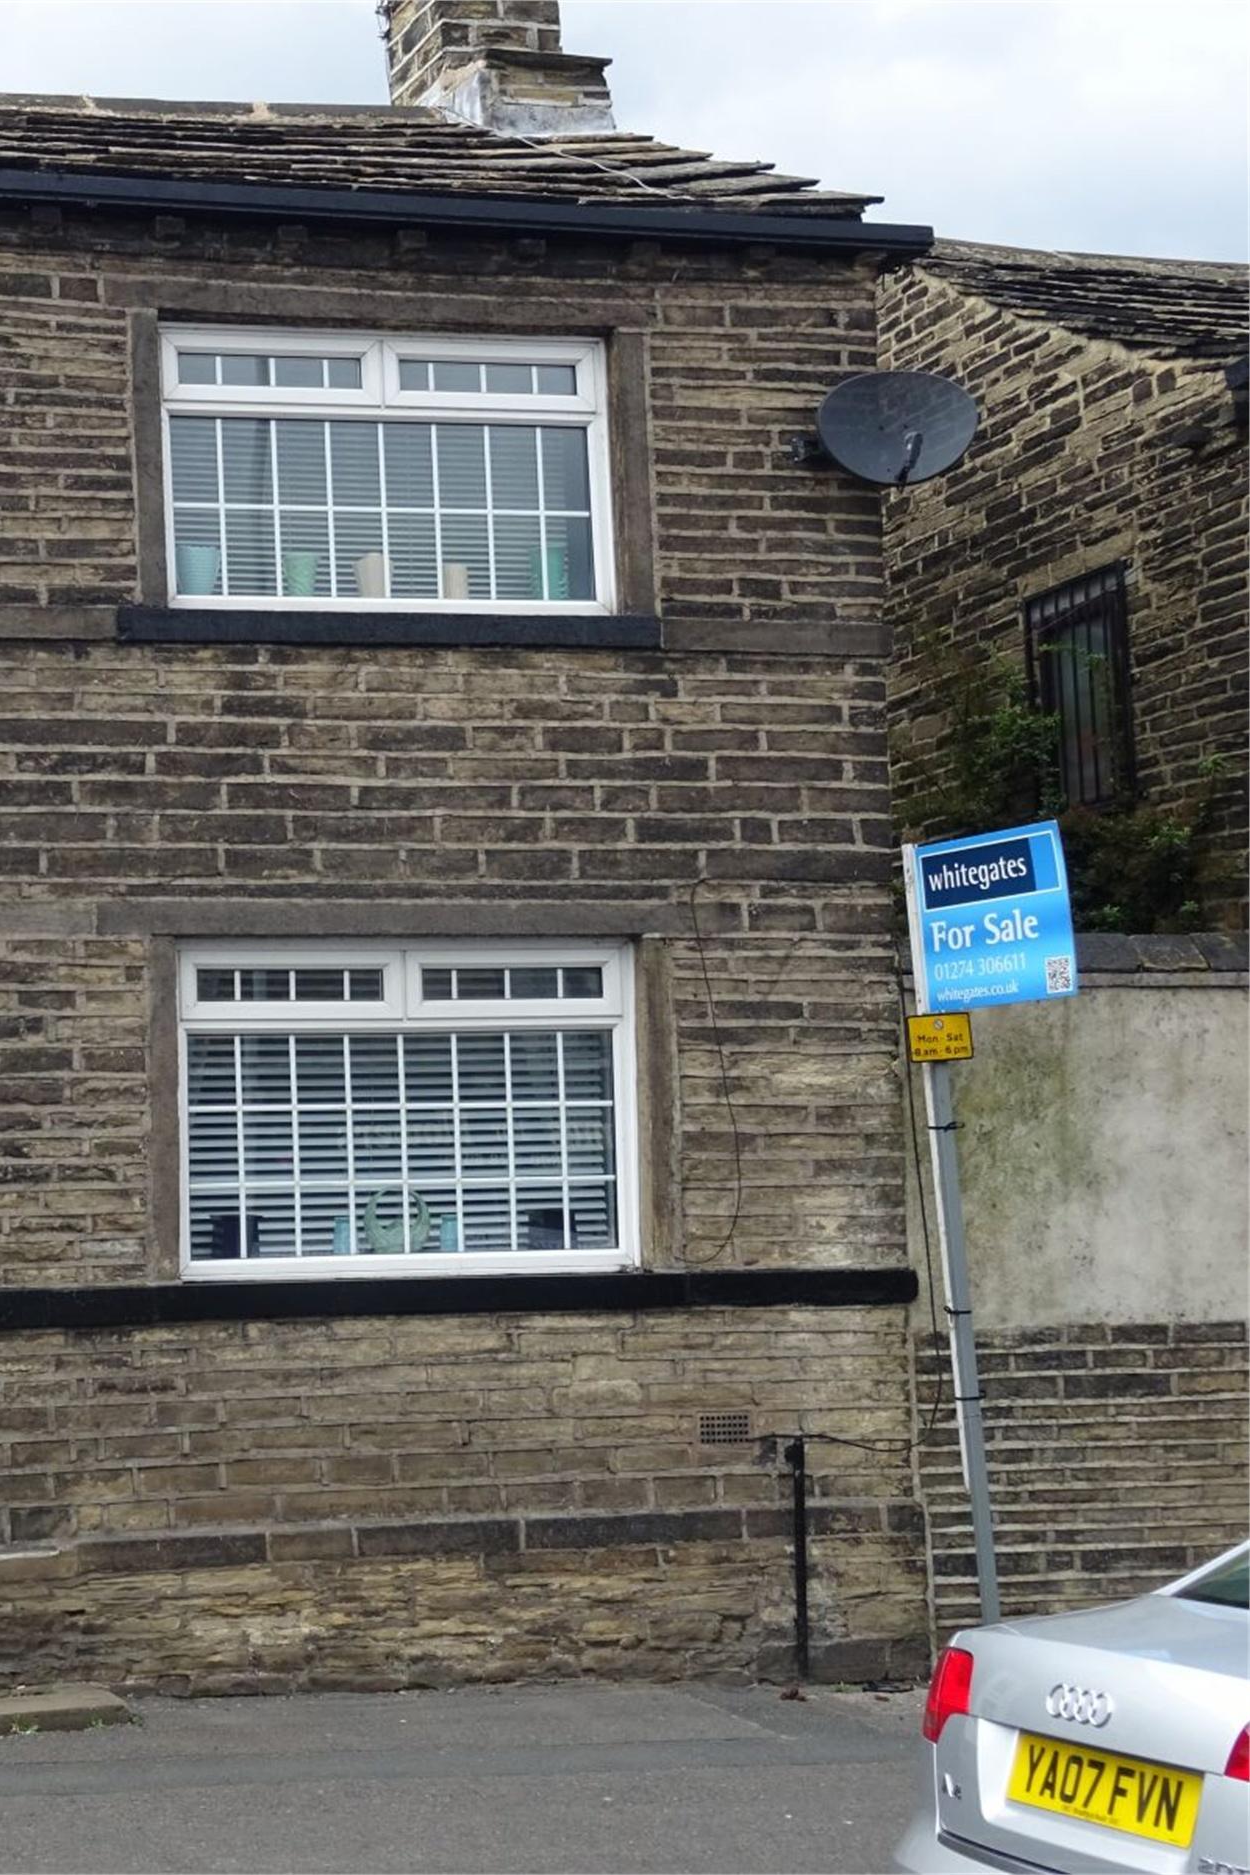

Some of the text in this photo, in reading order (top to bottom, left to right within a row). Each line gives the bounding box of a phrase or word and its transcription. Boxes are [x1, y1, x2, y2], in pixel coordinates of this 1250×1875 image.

[929, 856, 1027, 890] whitegates
[930, 909, 1039, 952] For Sale
[935, 952, 1026, 980] 01274 306611
[937, 979, 1019, 1003] whitegates.co.uk
[1024, 1744, 1183, 1831] YA07 FVN
